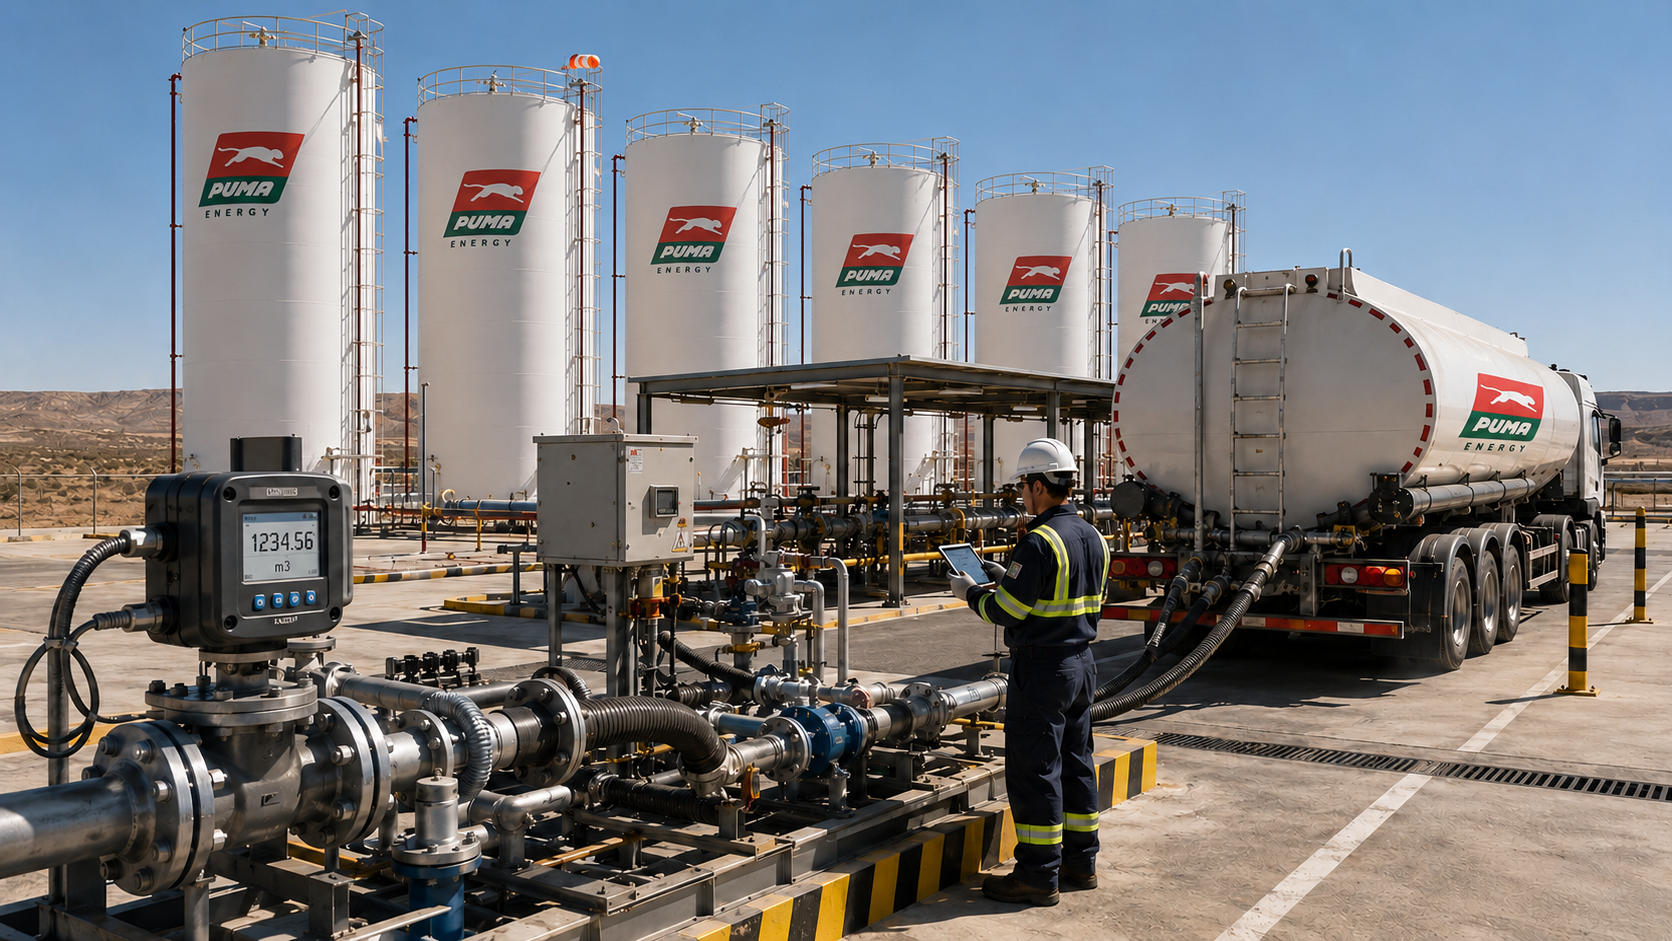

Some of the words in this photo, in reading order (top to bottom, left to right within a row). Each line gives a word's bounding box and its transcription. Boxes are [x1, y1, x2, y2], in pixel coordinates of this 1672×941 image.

[207, 181, 275, 199] PUMA
[205, 208, 269, 218] ENERGY
[453, 215, 516, 231] PUMA
[450, 239, 511, 248] ENERGY
[659, 245, 715, 259] PUMA
[657, 266, 711, 274] ENERGY
[843, 269, 894, 282] PUMA
[841, 288, 891, 296] ENERGY
[1007, 288, 1055, 300] PUMA
[1471, 416, 1532, 436] PUMA
[1463, 442, 1526, 452] ENERGY
[251, 531, 314, 552] 1234.56
[274, 560, 291, 573] m3
